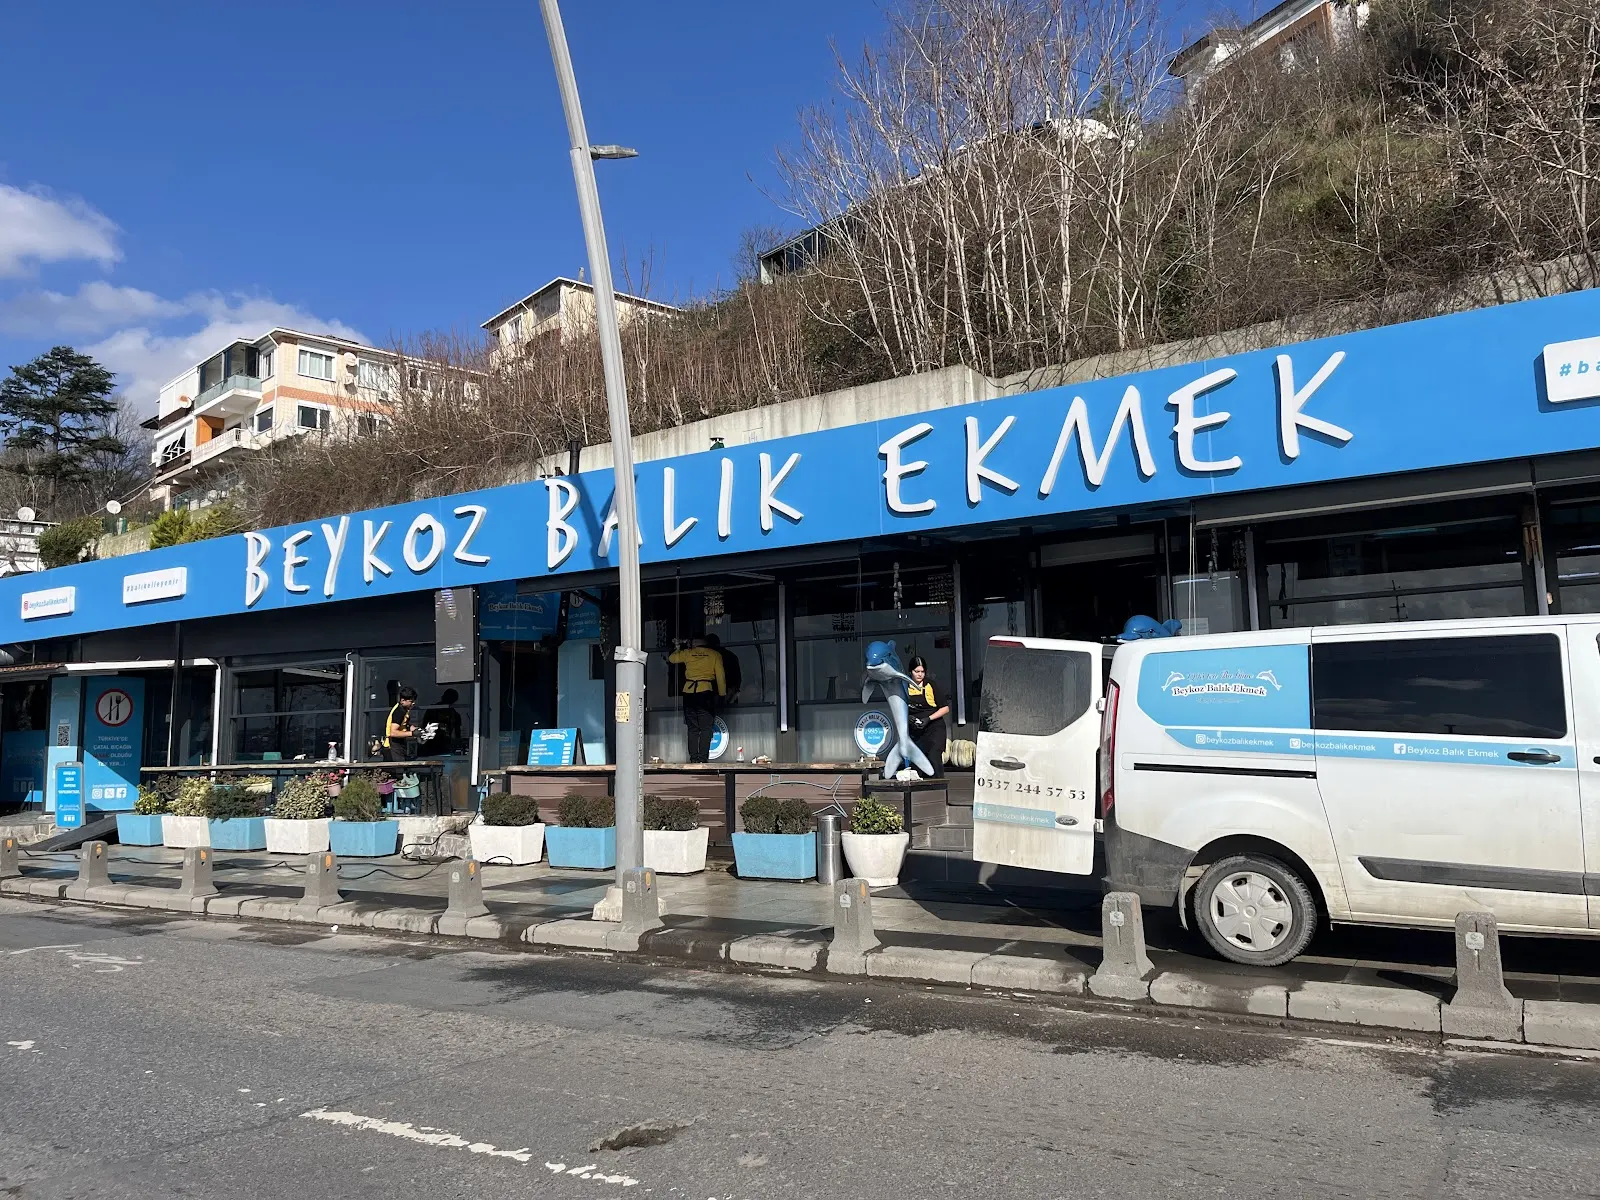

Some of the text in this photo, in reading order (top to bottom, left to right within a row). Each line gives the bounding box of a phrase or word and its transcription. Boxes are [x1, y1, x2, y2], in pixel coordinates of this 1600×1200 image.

[244, 504, 491, 608] BEYKOZ
[877, 350, 1355, 513] EKMEK
[1173, 684, 1265, 696] Beykoz Balık Ekmek
[1407, 746, 1499, 758] Beykoz Balık Ekmek
[977, 777, 1086, 800] 0537 244 57 53
[987, 811, 1050, 823] beykozbikekmek
